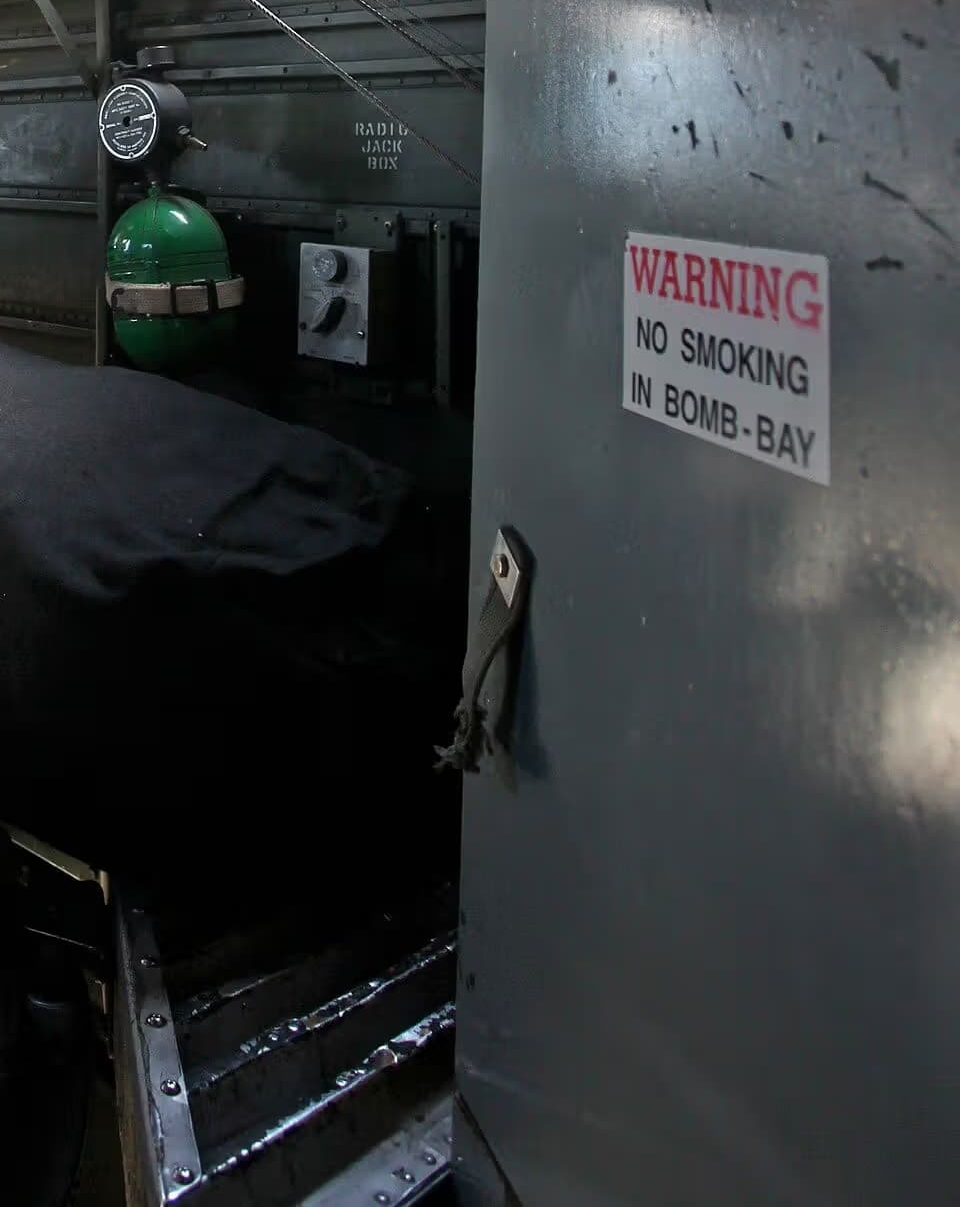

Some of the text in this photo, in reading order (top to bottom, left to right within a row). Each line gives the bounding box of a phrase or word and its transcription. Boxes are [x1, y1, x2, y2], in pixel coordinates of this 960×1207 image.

[361, 139, 402, 153] JACK
[367, 156, 398, 170] BOX
[630, 245, 823, 330] WARNING
[637, 316, 809, 397] NO SMOKING
[631, 371, 652, 409] IN
